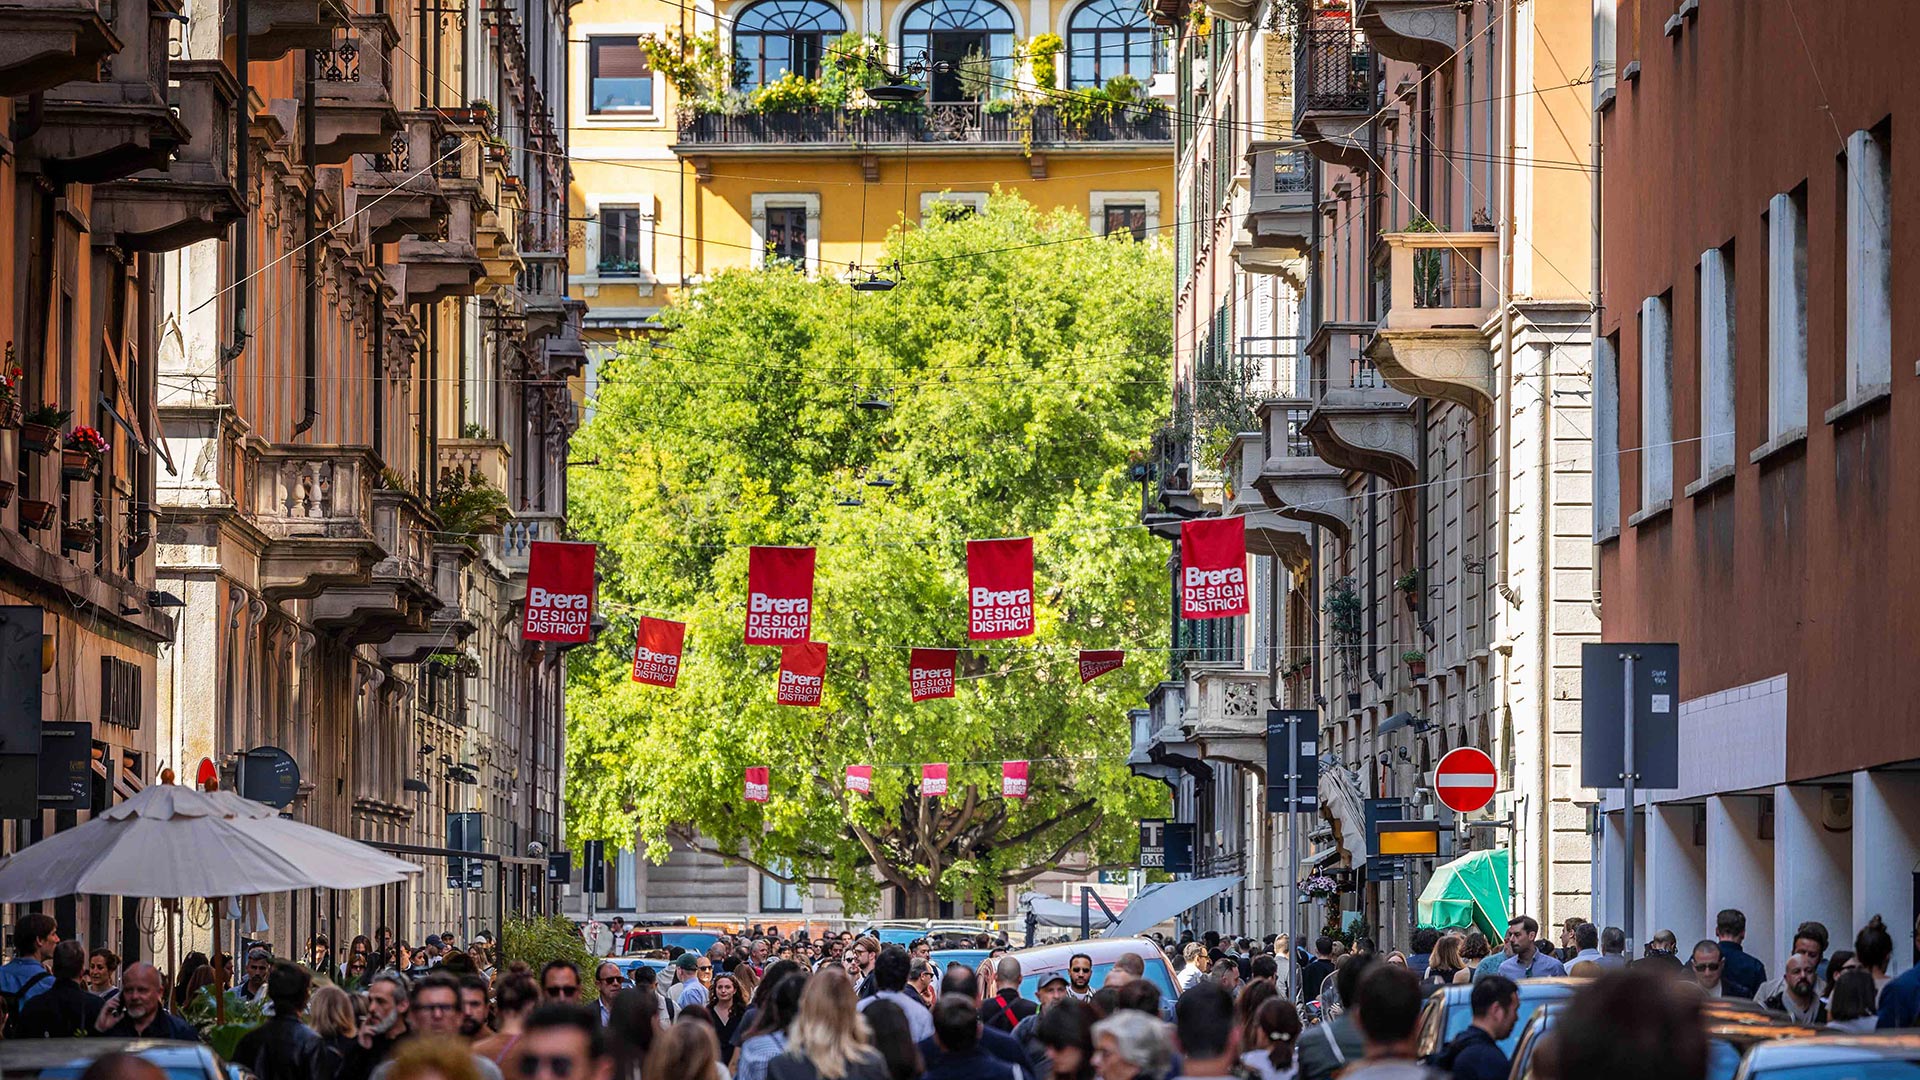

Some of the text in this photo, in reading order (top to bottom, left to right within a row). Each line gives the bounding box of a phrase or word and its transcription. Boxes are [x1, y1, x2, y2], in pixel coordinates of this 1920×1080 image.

[1185, 567, 1244, 586] Brera
[530, 587, 588, 609] Brera
[972, 587, 1030, 607] Brera
[1185, 583, 1245, 600] DESIGN
[750, 592, 809, 613] Brera
[1185, 596, 1245, 612] DISTRICT
[528, 608, 588, 623] DESIGN
[972, 604, 1031, 620] DESIGN
[526, 620, 586, 635] DISTRICT
[749, 613, 808, 627] DESIGN
[972, 617, 1031, 632] DISTRICT
[748, 626, 807, 639] DISTRICT
[637, 646, 678, 666] Brera
[635, 660, 676, 674] DESIGN
[912, 668, 952, 680] Brera
[634, 668, 674, 683] DISTRICT
[781, 670, 821, 686] Brera
[780, 684, 820, 695] DESIGN
[912, 678, 952, 689] DESIGN
[913, 685, 951, 697] DISTRICT
[778, 692, 819, 702] DISTRICT
[1141, 822, 1165, 847] T
